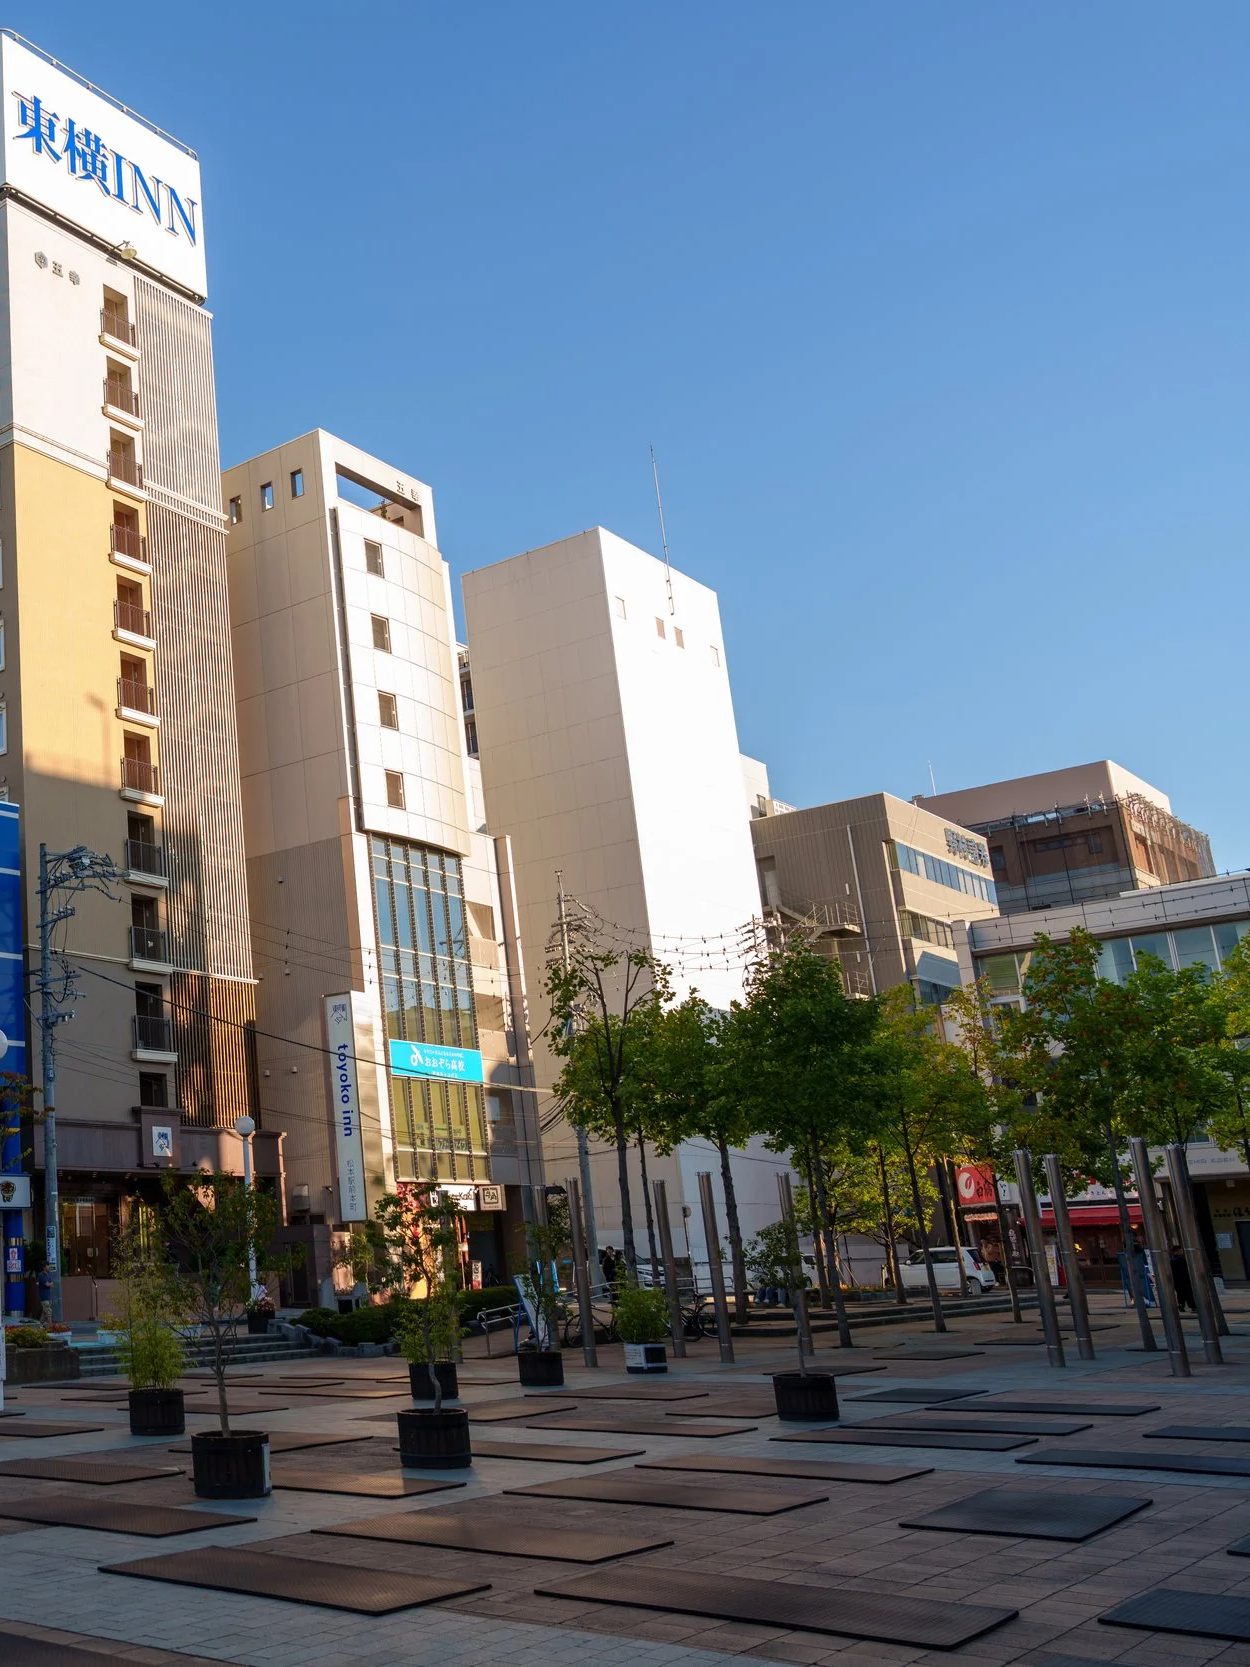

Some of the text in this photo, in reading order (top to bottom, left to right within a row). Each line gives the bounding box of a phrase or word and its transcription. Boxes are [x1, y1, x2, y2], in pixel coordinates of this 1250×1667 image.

[12, 91, 198, 246] 東横INN
[337, 1044, 354, 1137] toyoko inn
[424, 1056, 465, 1071] おおぞら高校
[346, 1159, 357, 1212] 松本駅前本町
